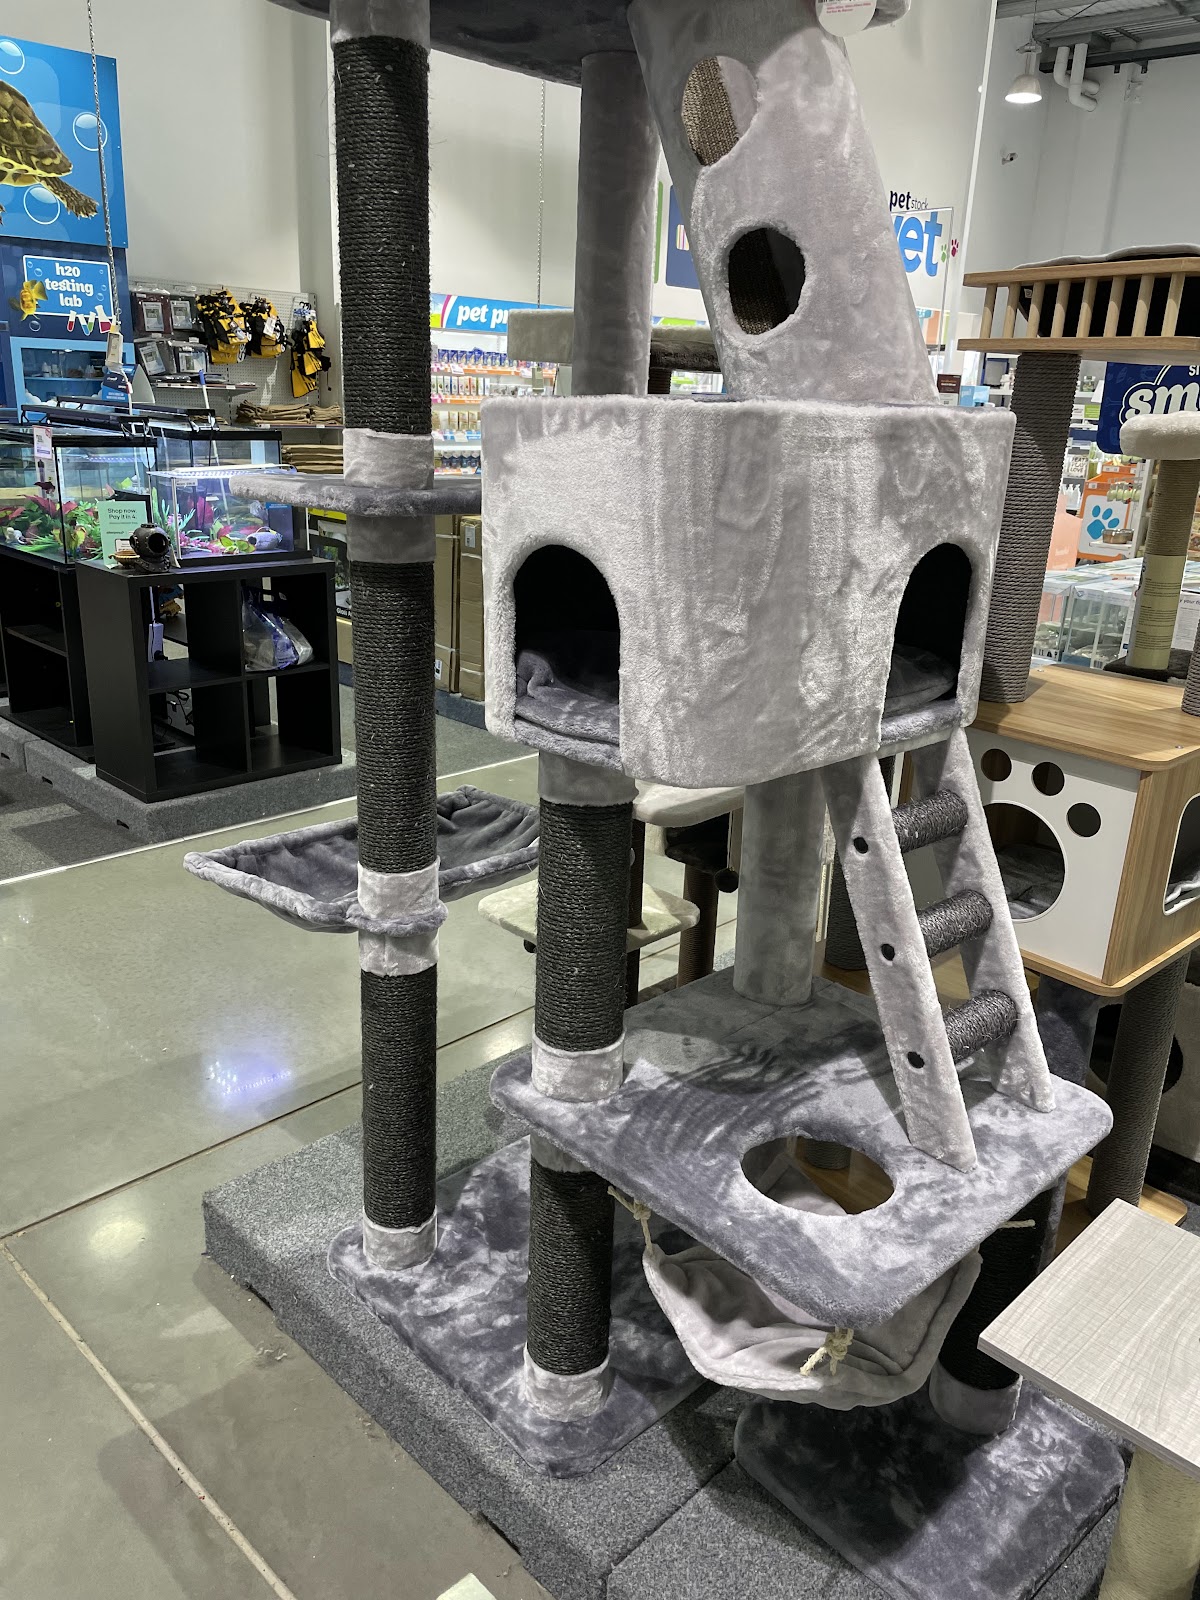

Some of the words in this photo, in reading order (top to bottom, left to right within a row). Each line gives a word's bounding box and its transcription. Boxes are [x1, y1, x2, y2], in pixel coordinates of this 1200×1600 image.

[44, 278, 94, 297] testing
[59, 293, 83, 307] lab
[456, 304, 489, 326] pet
